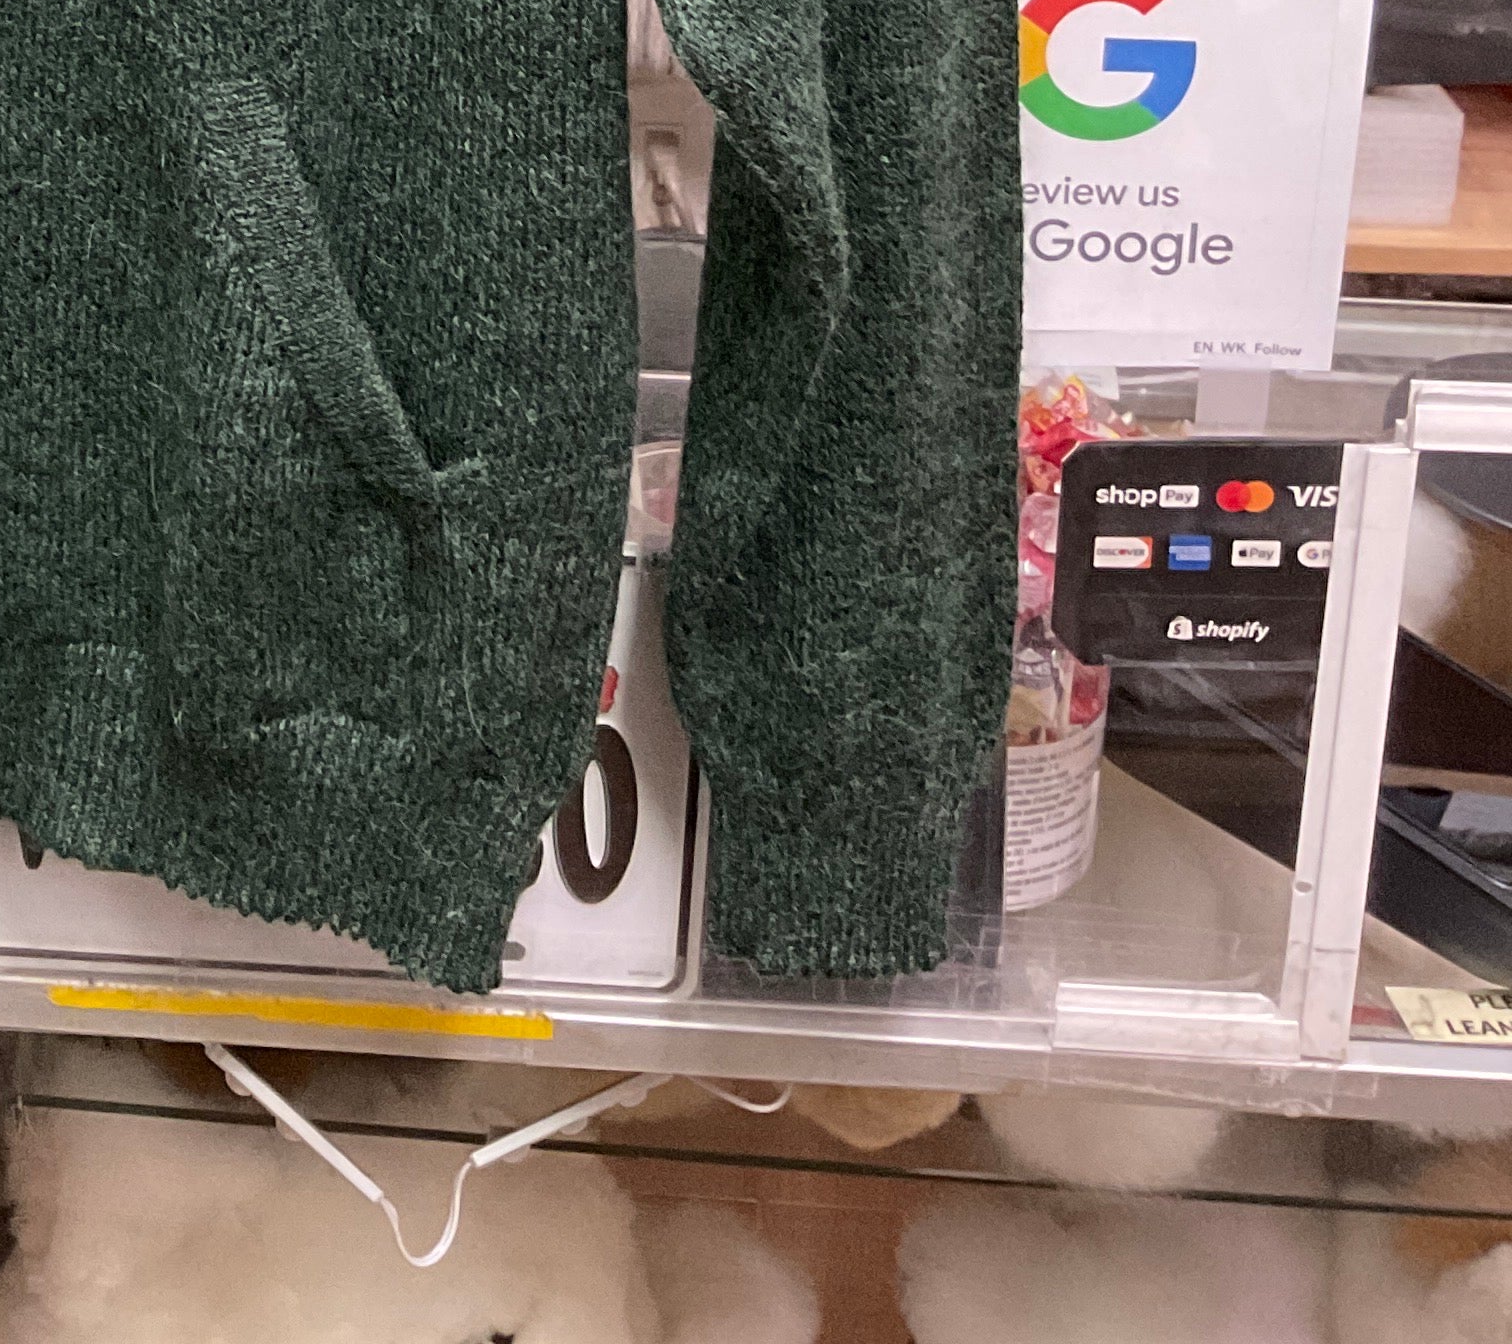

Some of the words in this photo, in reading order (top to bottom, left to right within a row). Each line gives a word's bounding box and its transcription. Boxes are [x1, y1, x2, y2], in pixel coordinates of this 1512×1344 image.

[1138, 185, 1180, 207] us
[1029, 218, 1234, 276] Google
[1193, 341, 1213, 354] EN
[1254, 342, 1302, 356] Follow
[1095, 484, 1157, 508] shop
[1165, 490, 1194, 503] Pay
[1250, 547, 1274, 561] Pay
[1196, 620, 1270, 643] shopify
